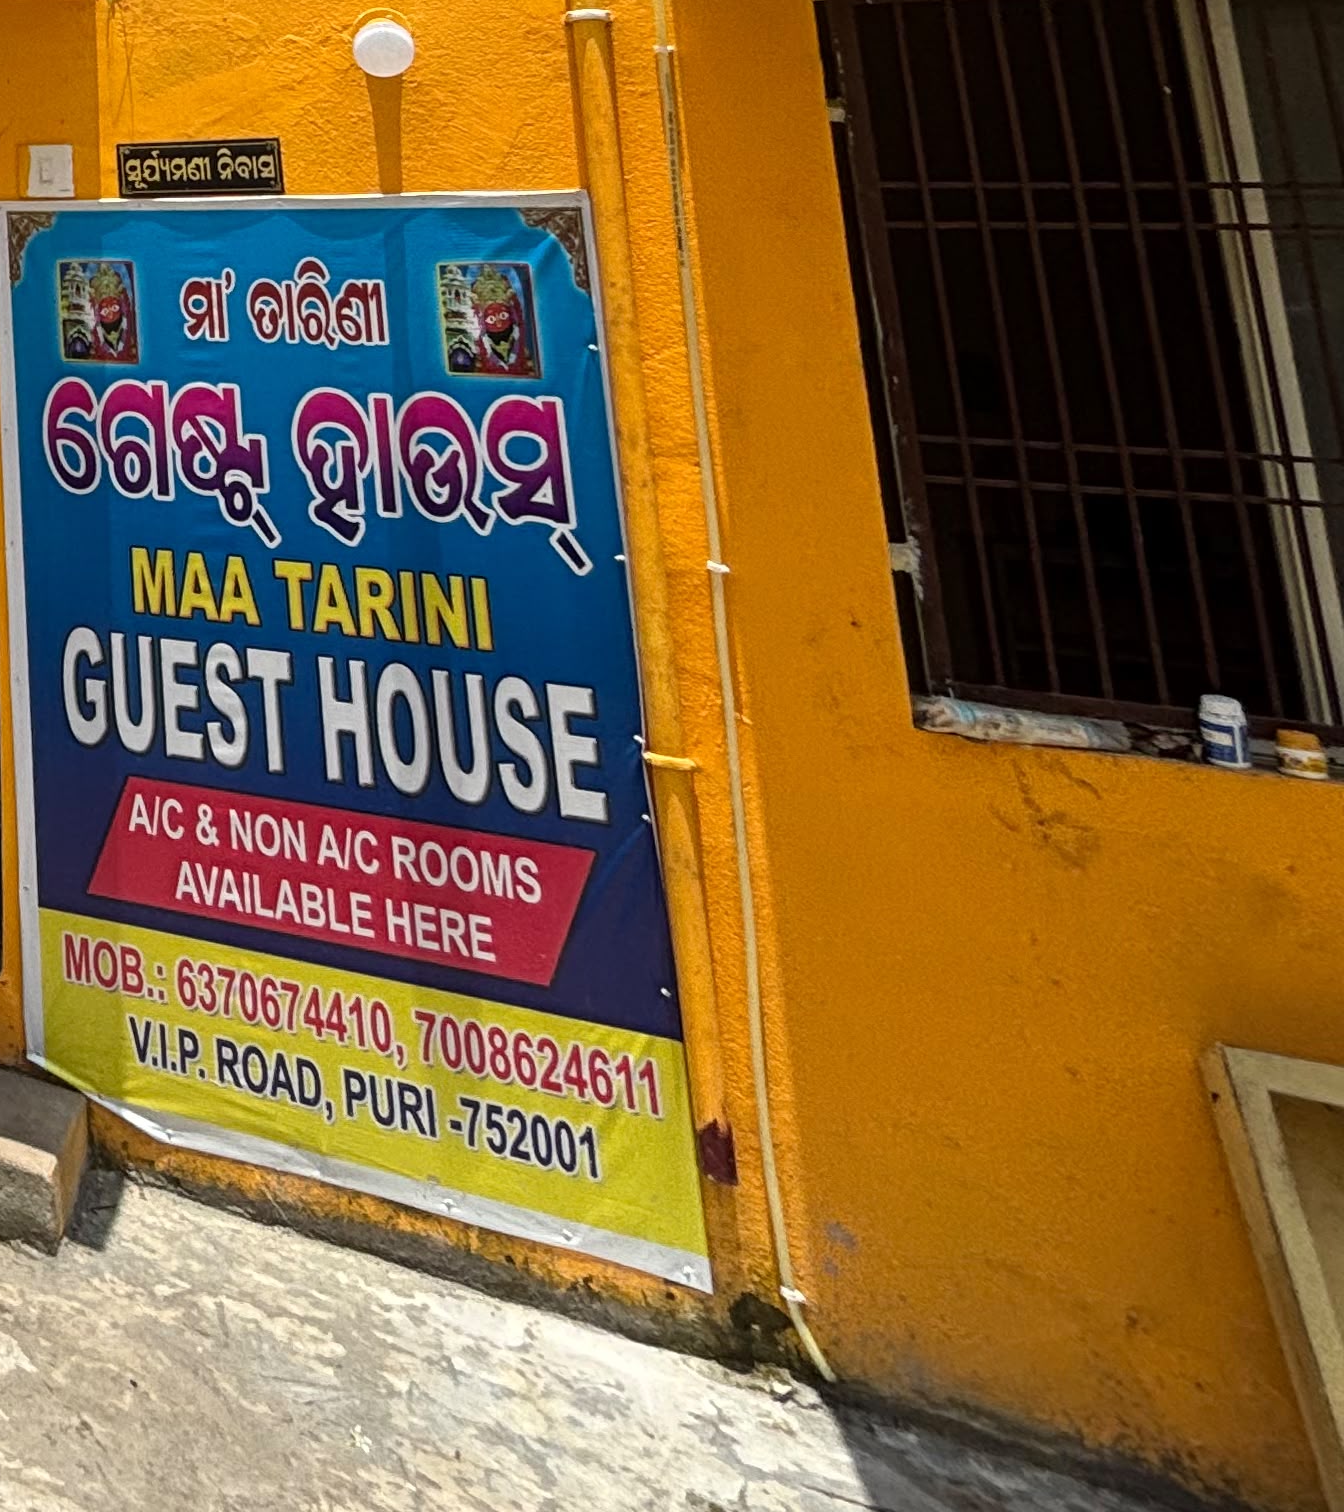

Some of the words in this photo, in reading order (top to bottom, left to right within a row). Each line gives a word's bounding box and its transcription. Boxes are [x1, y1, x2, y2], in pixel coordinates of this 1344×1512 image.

[218, 147, 276, 180] ନିବାସ
[247, 257, 390, 350] ତାରିଣୀ
[292, 387, 593, 576] ହାଉସ୍
[131, 546, 261, 627] MAA
[273, 559, 495, 652] TARINI
[63, 626, 293, 774] GUEST
[317, 655, 609, 823] HOUSE
[128, 793, 185, 840] A/C
[195, 804, 220, 847] &
[229, 808, 308, 863] NON
[317, 824, 381, 875] A/C
[391, 836, 542, 904] ROOMS
[175, 861, 376, 938] AVAILABLE
[385, 898, 497, 963] HERE
[177, 959, 405, 1067] 6370674410,
[414, 1009, 660, 1116] 7008624611
[129, 1015, 207, 1080] V.I.P.
[216, 1037, 334, 1121] ROAD,
[342, 1068, 439, 1138] PURI
[449, 1096, 599, 1179] -752001
